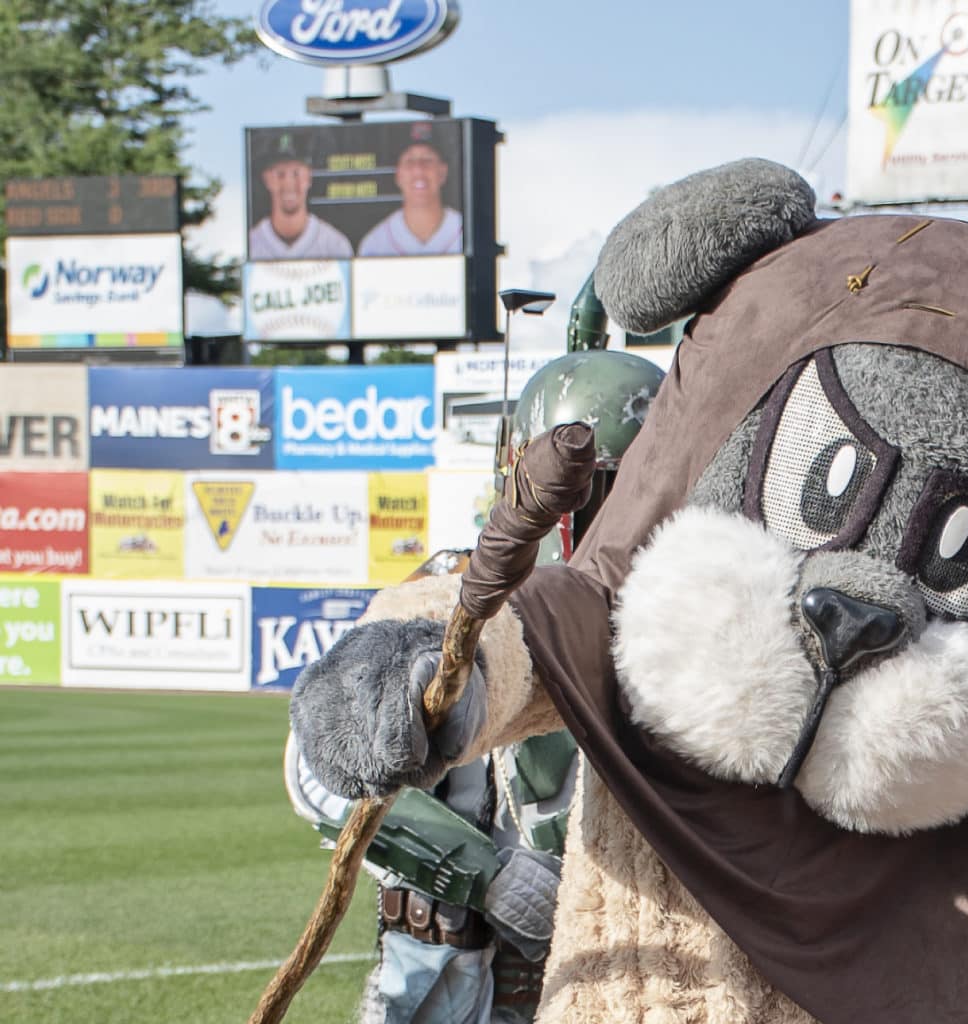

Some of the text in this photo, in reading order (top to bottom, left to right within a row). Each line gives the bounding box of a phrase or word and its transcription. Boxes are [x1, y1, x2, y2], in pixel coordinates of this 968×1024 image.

[291, 0, 401, 45] Ford
[873, 28, 929, 67] ON
[54, 258, 166, 294] Norway
[252, 289, 294, 313] CALL
[253, 504, 321, 524] Buckle
[377, 495, 418, 512] Watch
[14, 551, 43, 568] you
[46, 547, 82, 569] buy!
[4, 621, 55, 649] you
